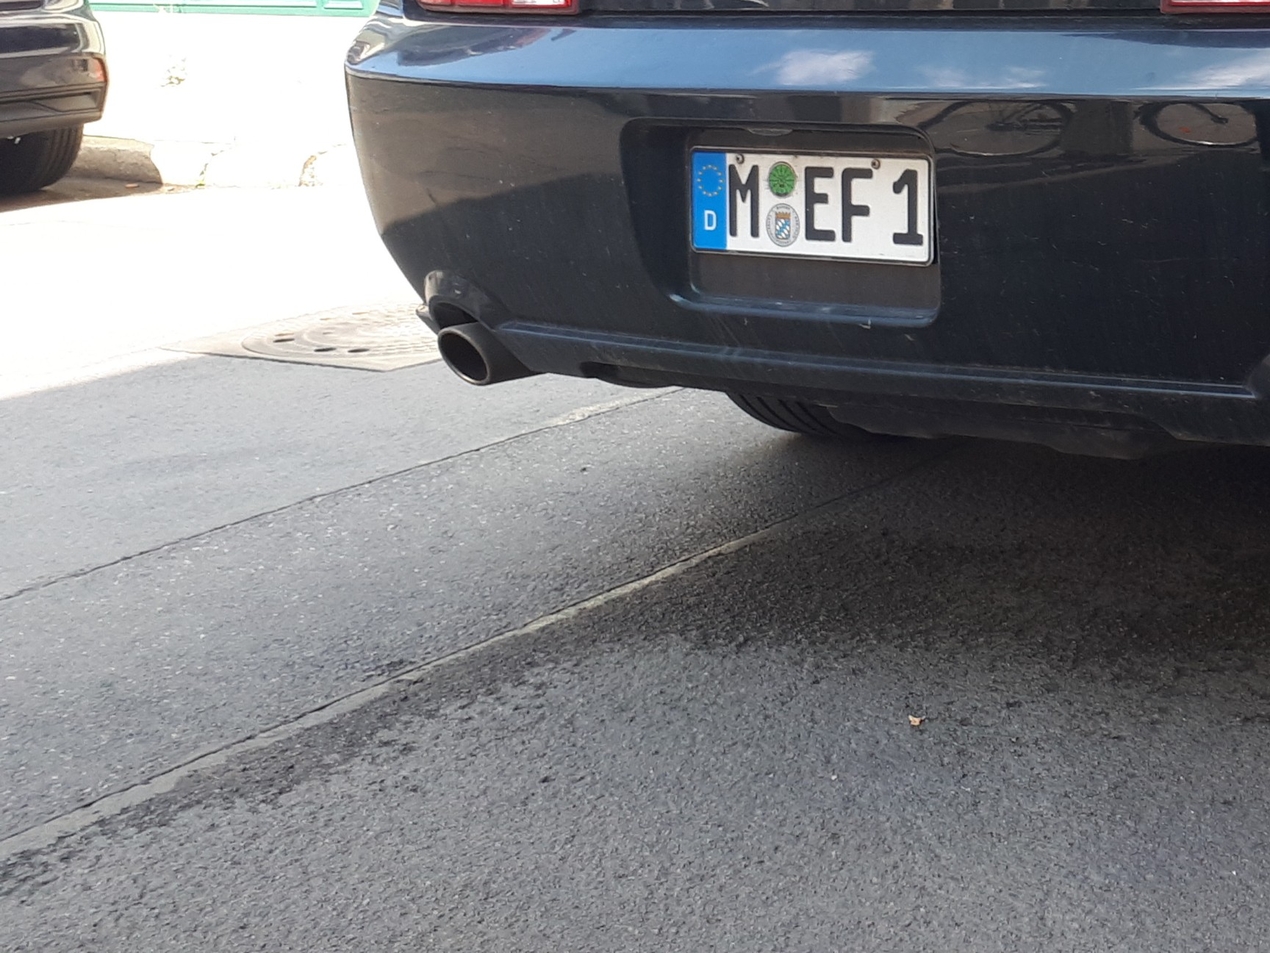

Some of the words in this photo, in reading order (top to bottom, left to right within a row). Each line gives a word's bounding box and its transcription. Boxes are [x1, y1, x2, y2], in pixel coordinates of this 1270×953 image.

[704, 210, 717, 231] D
[728, 164, 760, 238] M
[804, 166, 874, 243] EF
[892, 168, 924, 246] 1
